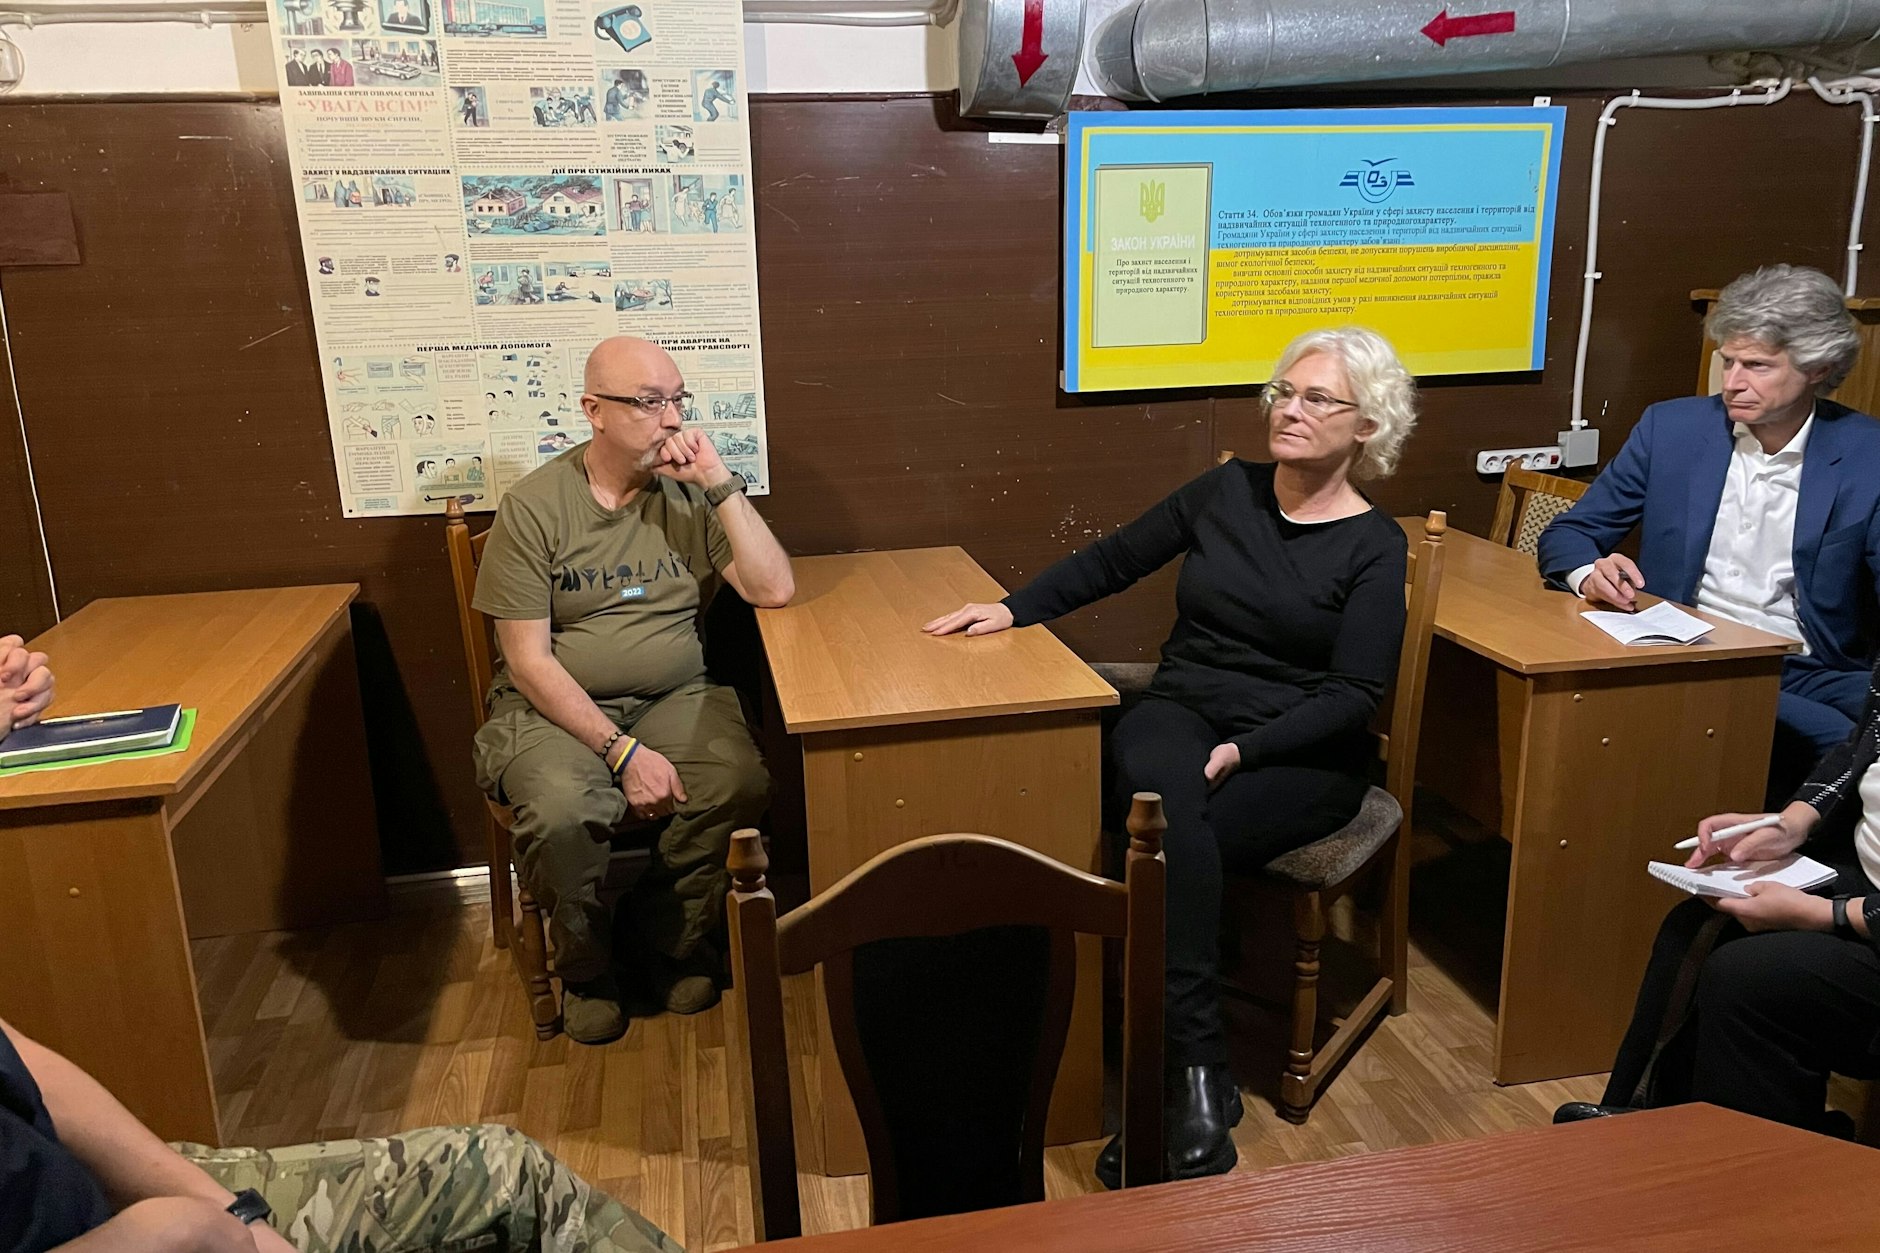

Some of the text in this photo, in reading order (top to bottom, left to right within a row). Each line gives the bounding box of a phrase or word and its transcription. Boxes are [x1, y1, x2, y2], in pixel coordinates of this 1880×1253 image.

[1219, 210, 1244, 219] Стаття
[1247, 209, 1258, 218] 34.
[1306, 210, 1341, 218] громадян
[1343, 207, 1374, 218] України
[1383, 207, 1404, 218] сфері
[1406, 208, 1434, 216] захисту
[1476, 206, 1479, 214] і
[1523, 204, 1535, 213] від
[1218, 220, 1272, 229] надзвичайних
[1274, 219, 1308, 228] ситуацій
[1310, 218, 1361, 227] техногенного
[1260, 229, 1290, 238] України
[1298, 229, 1318, 238] сфері
[1429, 226, 1439, 234] від
[1112, 234, 1196, 250] ЗАКОН УКРАЇНИ
[1116, 259, 1130, 267] Про
[622, 588, 642, 596] 2022
